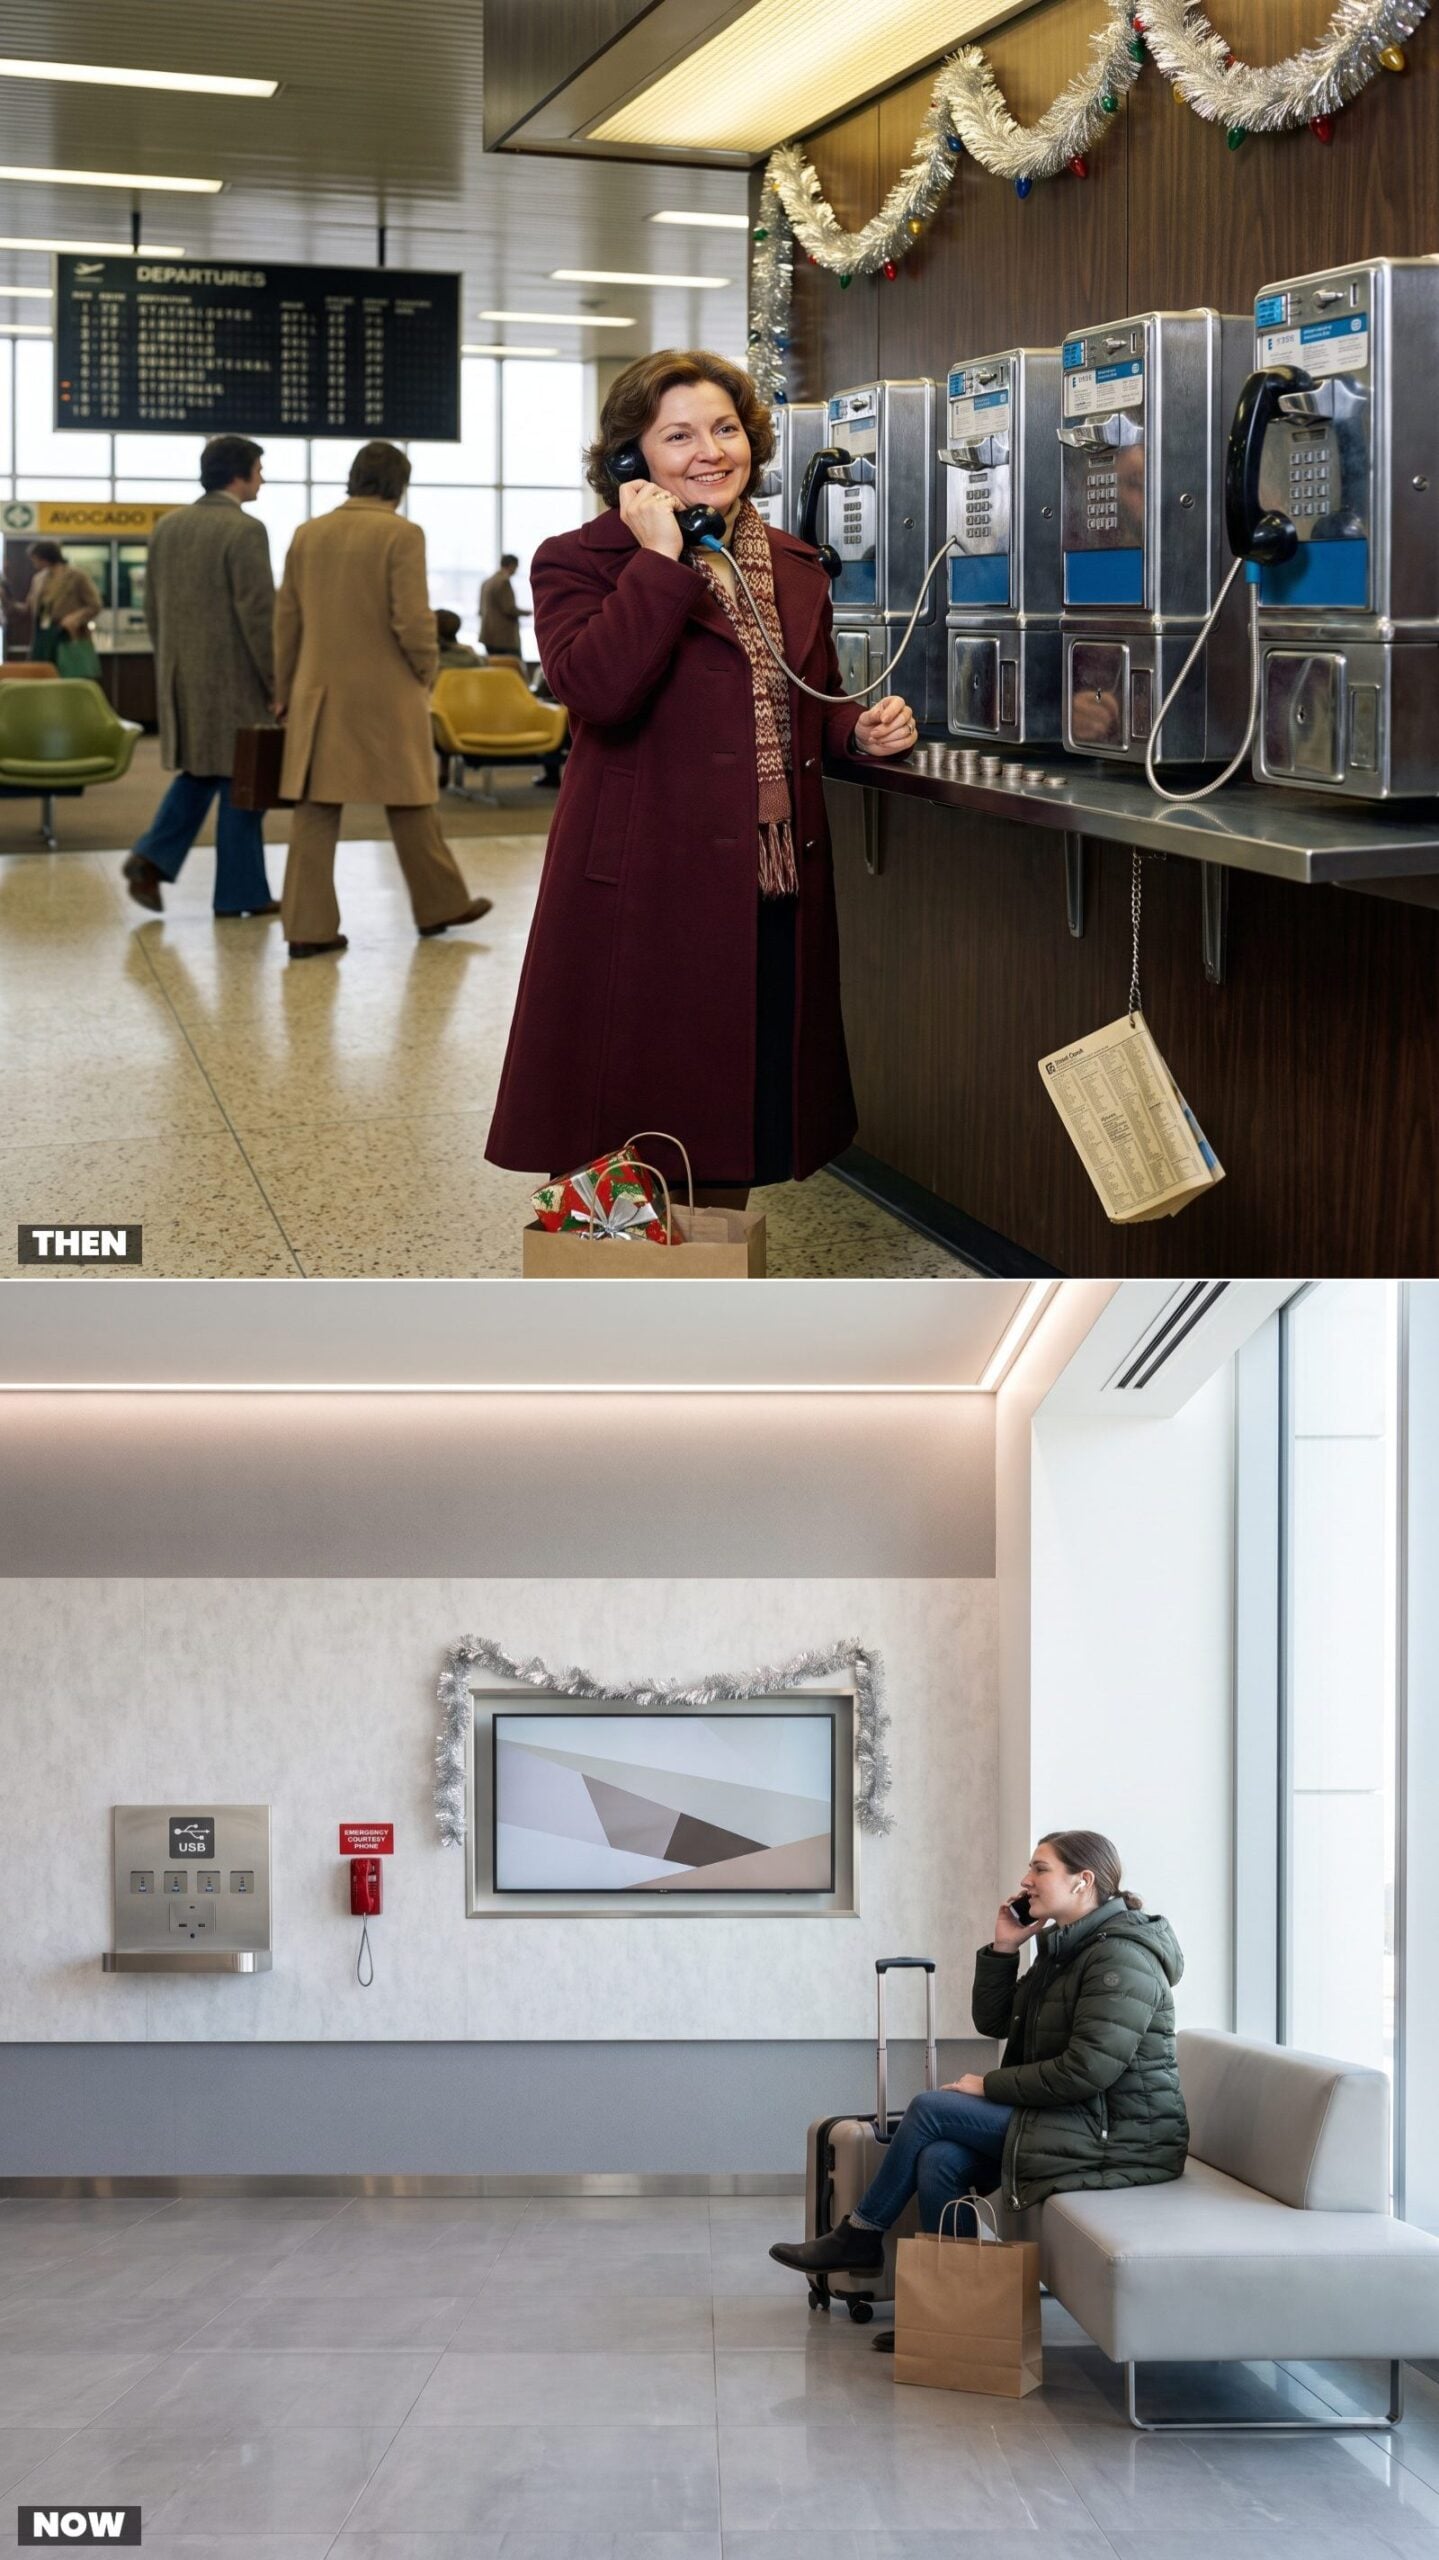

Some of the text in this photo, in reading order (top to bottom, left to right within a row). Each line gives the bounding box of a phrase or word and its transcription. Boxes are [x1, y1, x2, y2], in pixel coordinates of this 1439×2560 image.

[136, 265, 266, 288] DEPARTURES
[50, 510, 147, 526] AVOCADO
[178, 1842, 206, 1852] USB
